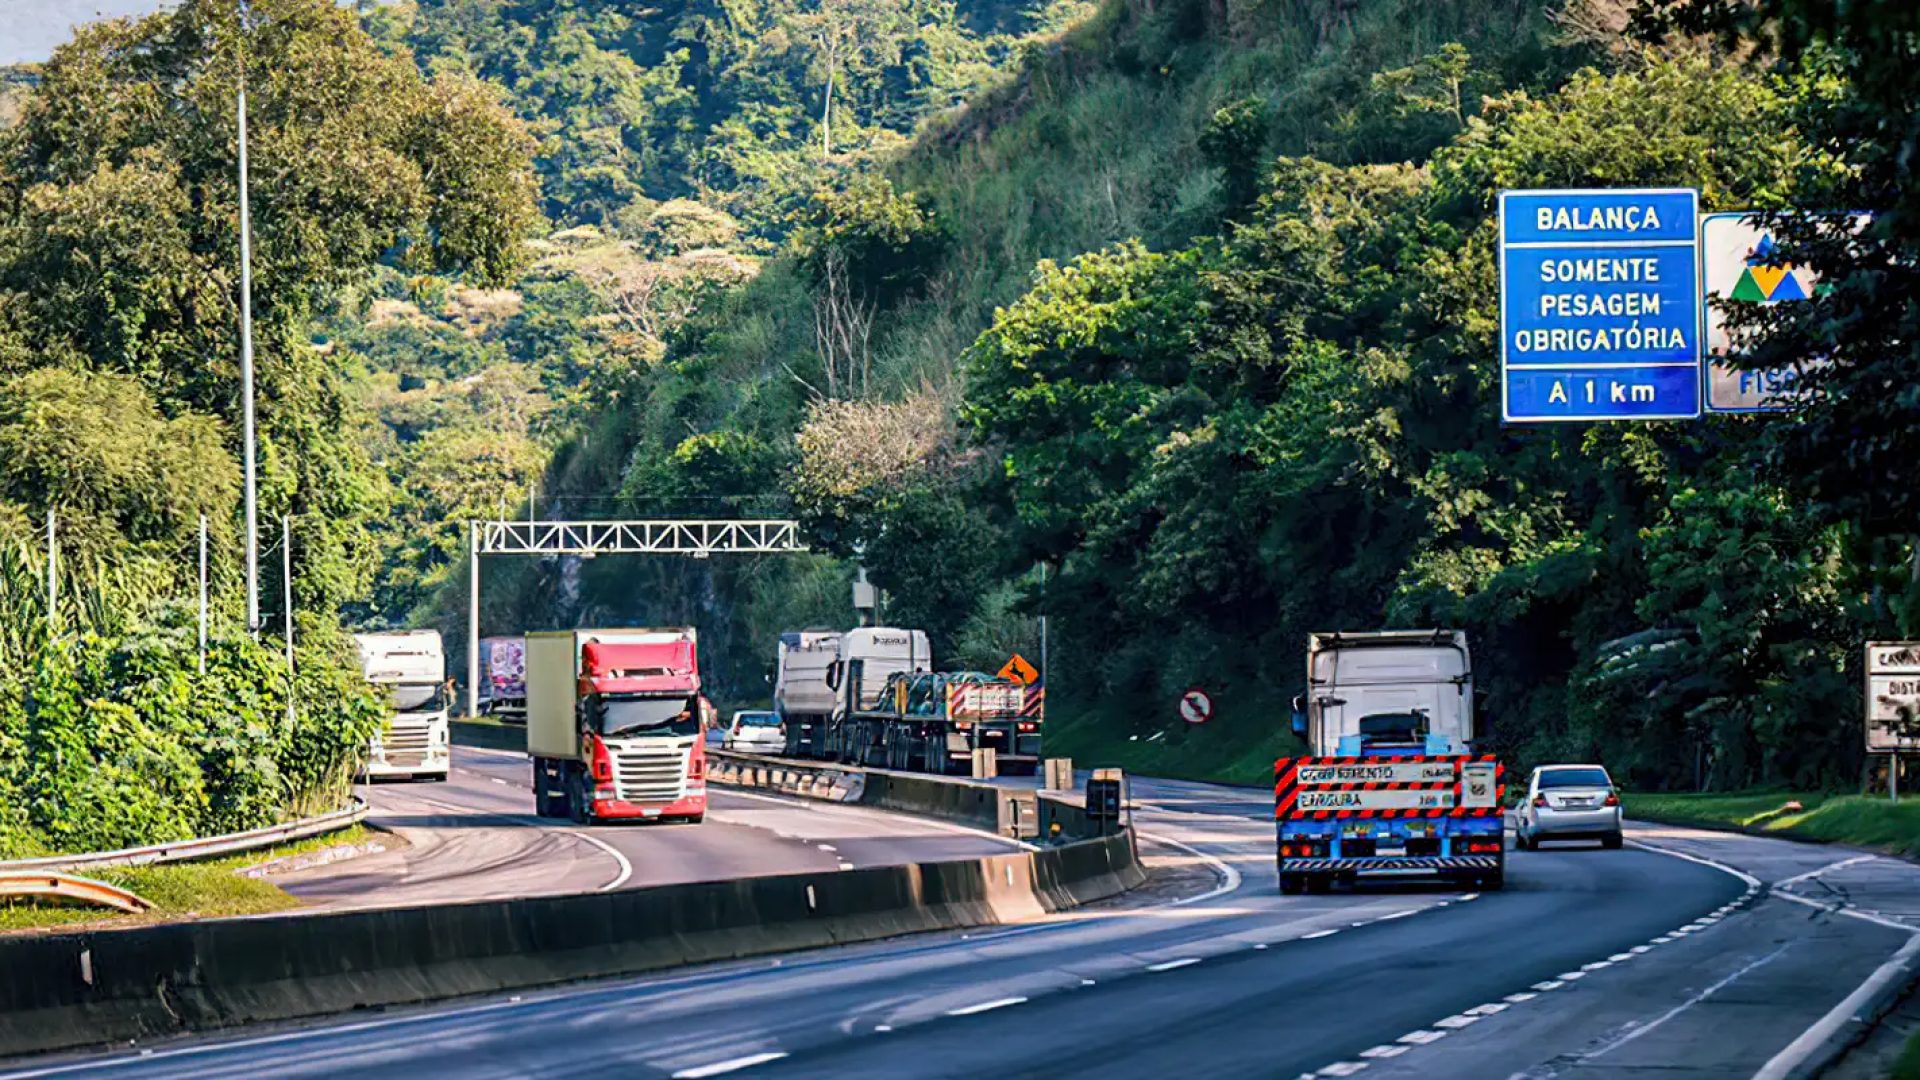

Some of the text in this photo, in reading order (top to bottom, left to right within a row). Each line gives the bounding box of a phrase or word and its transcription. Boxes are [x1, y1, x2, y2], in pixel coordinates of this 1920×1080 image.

[1537, 206, 1661, 232] BALANÇA
[1541, 258, 1659, 282] SOMENTE
[1541, 293, 1660, 317] PESAGEM
[1515, 321, 1686, 351] OBRIGATÓRIA
[1548, 381, 1655, 403] A 1 km
